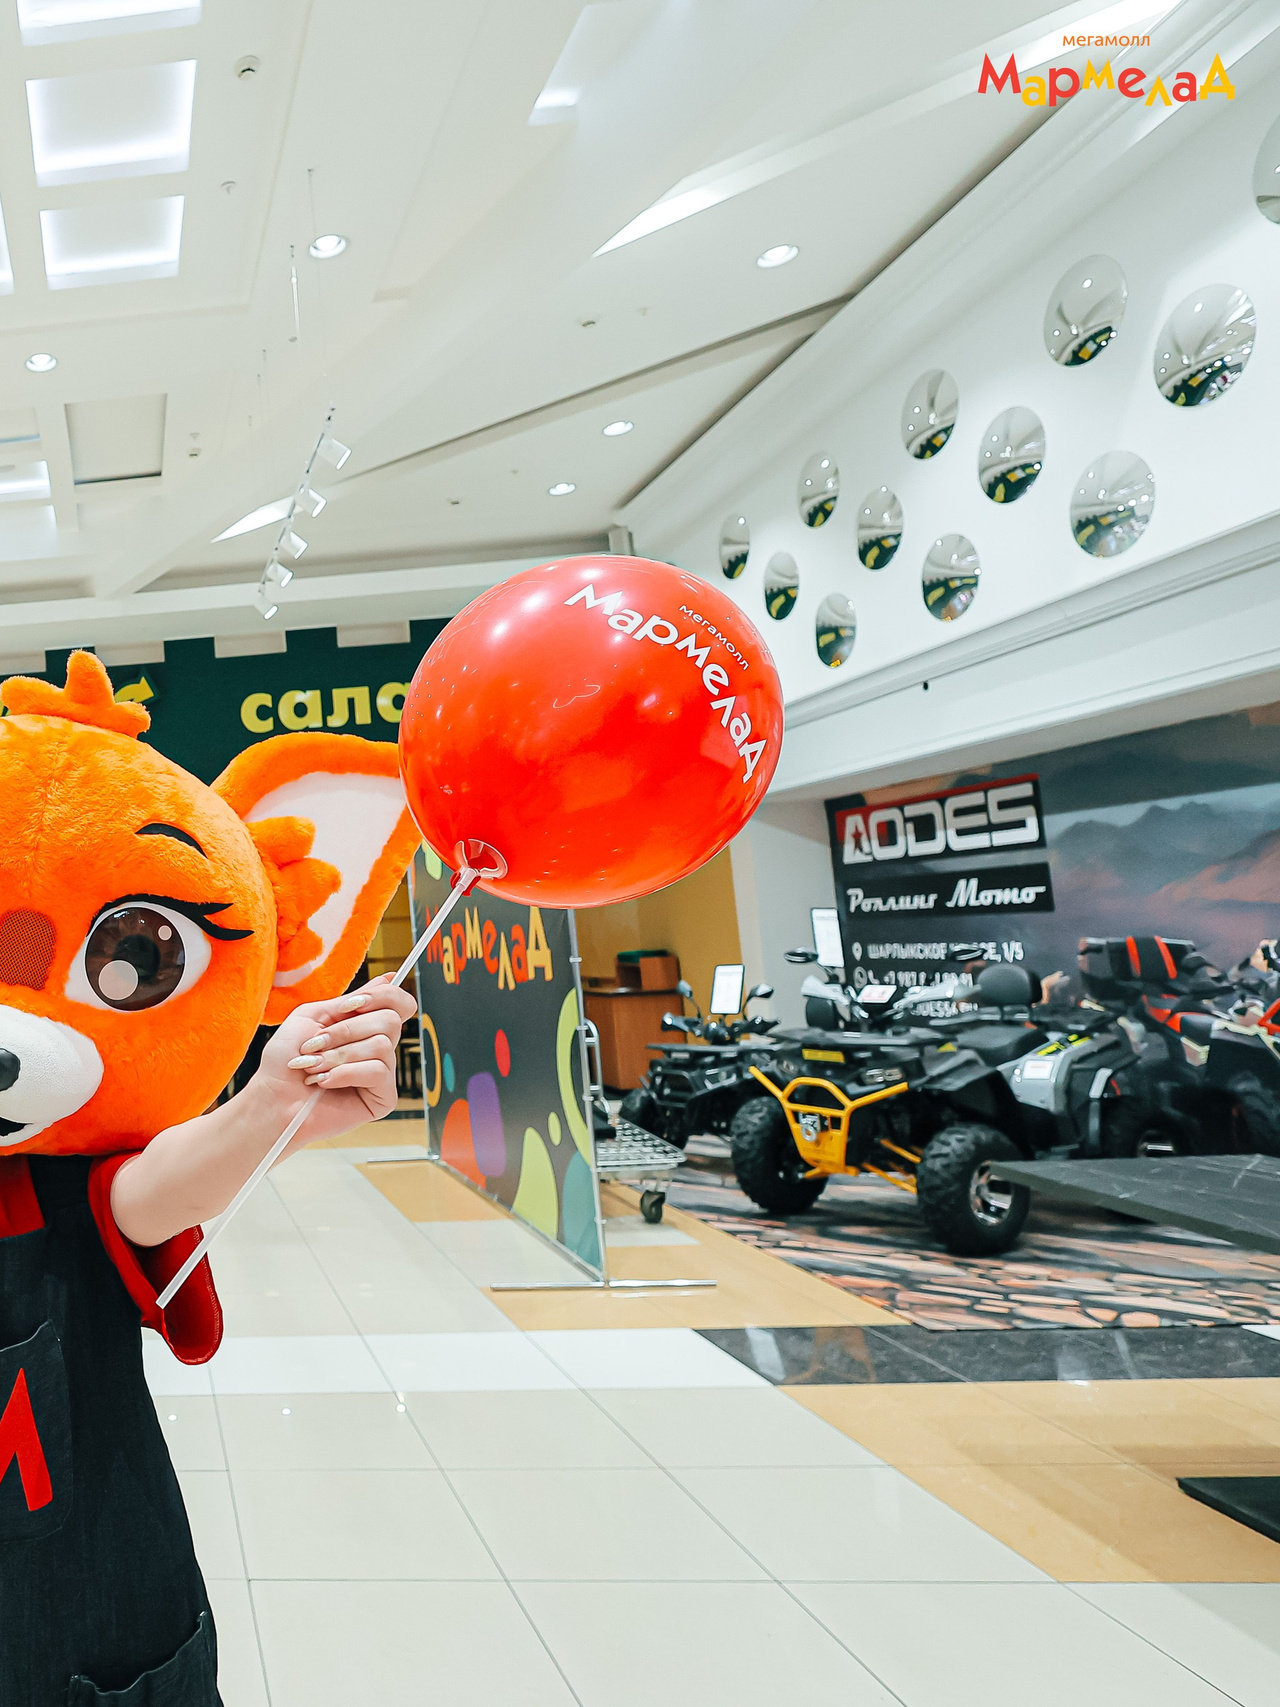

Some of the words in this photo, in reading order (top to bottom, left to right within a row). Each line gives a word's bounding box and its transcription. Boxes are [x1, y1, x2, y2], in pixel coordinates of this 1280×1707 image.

[678, 604, 749, 671] мегамолл
[842, 782, 1040, 865] AODES
[846, 888, 938, 913] Роллинг
[945, 877, 1046, 908] Мото
